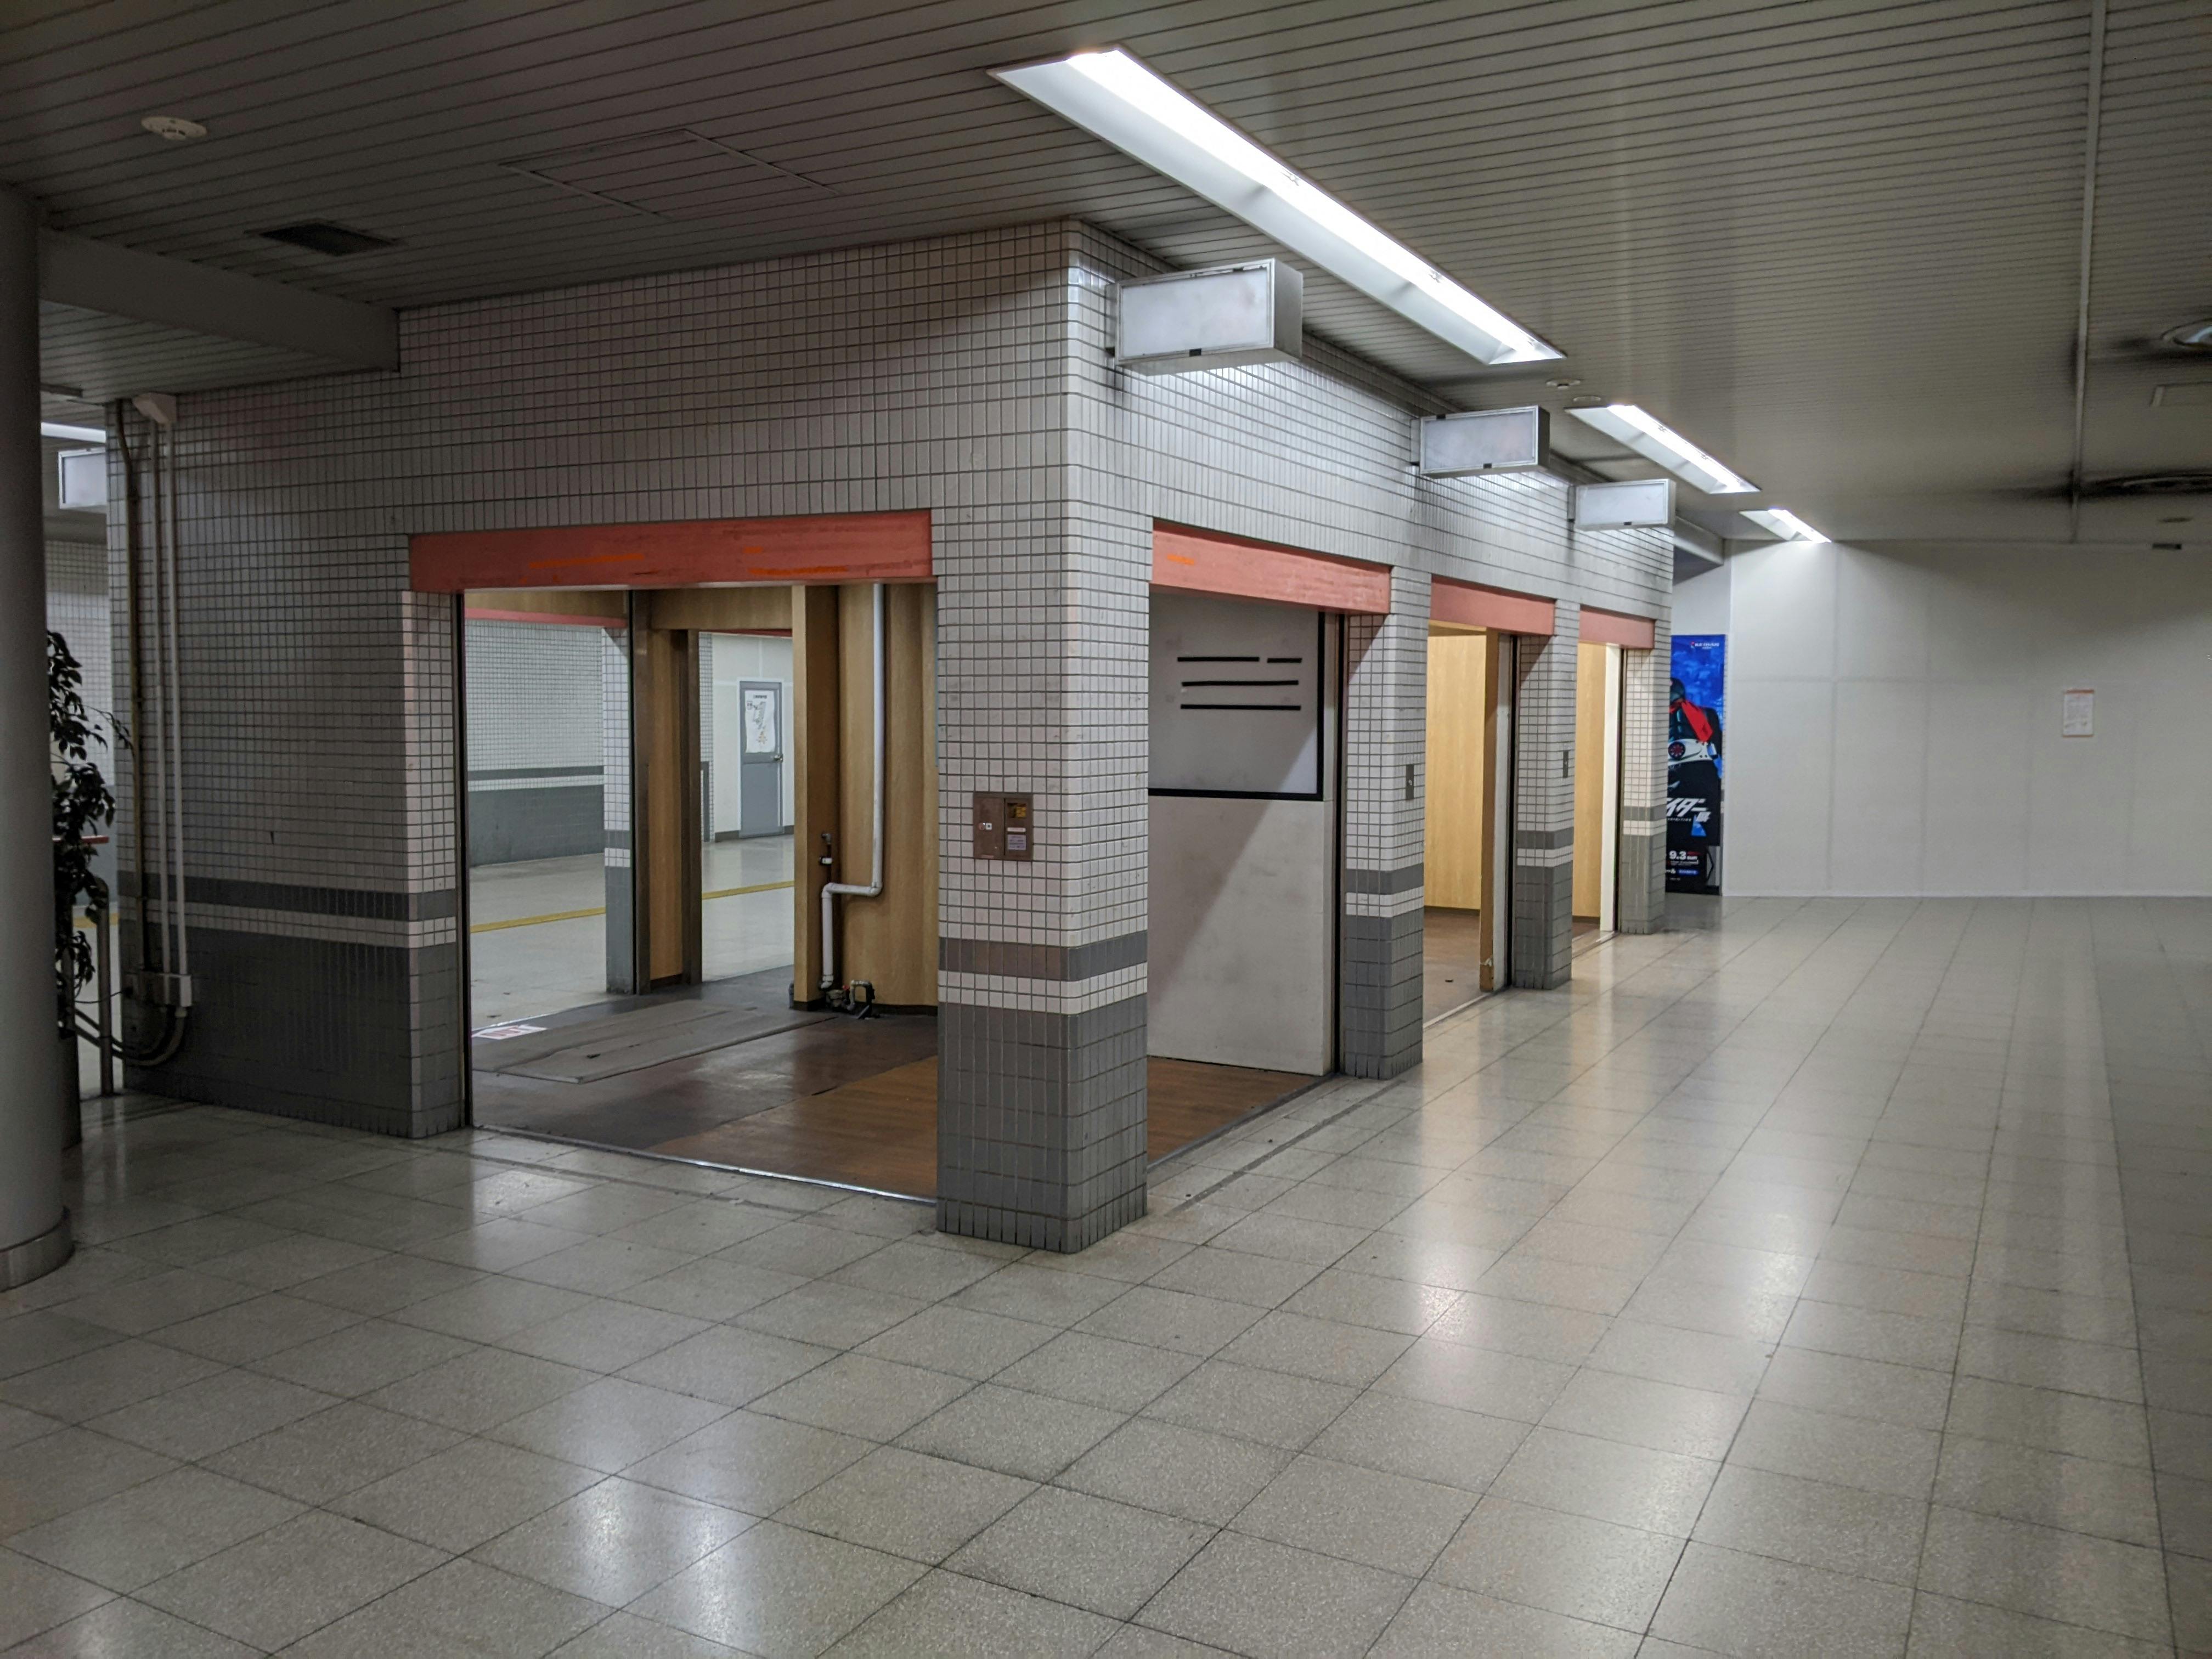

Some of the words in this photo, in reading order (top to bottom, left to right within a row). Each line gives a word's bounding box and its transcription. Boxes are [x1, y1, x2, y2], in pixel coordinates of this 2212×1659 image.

[1667, 798, 1708, 817] イダー
[1669, 850, 1686, 860] 9.3
